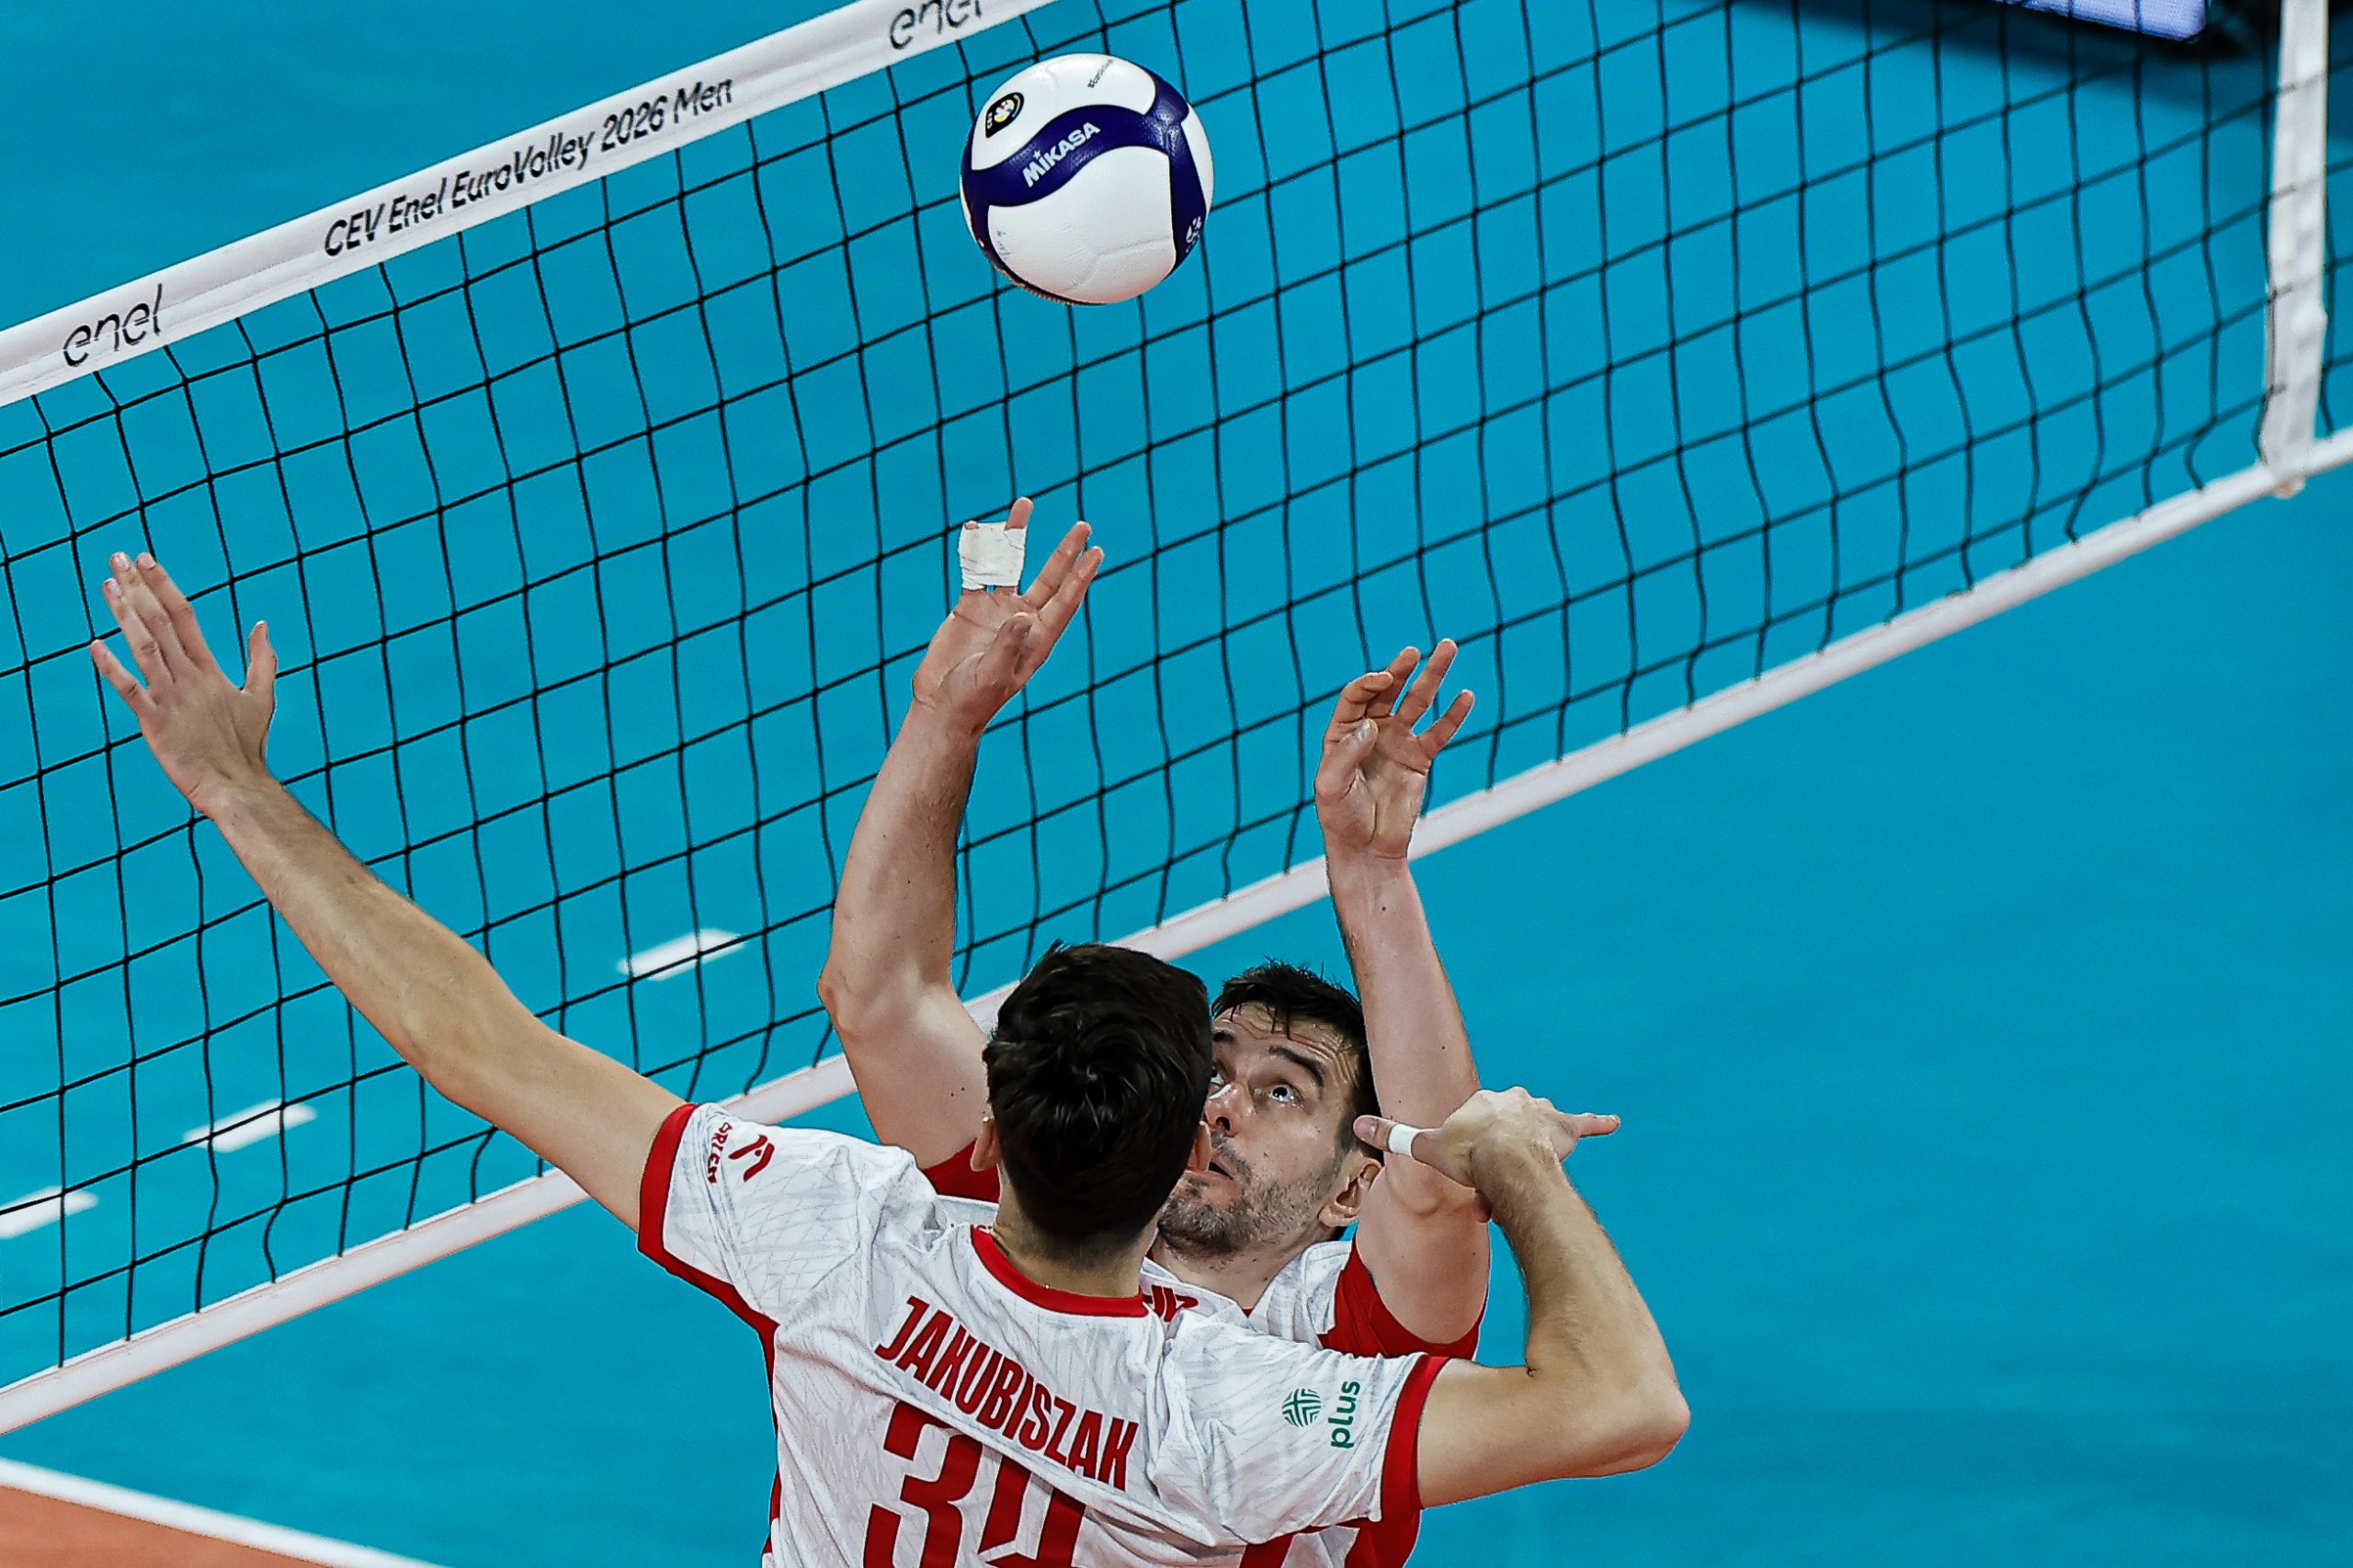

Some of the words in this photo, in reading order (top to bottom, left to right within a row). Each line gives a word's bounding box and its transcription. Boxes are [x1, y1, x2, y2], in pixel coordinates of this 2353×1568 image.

[324, 201, 384, 256] CEV
[389, 177, 448, 234] Enel
[451, 130, 596, 209] EuroVolley
[600, 95, 668, 153] 2026
[674, 77, 733, 124] Men
[63, 282, 163, 368] enel
[874, 1294, 1140, 1492] JAKUBISZAK
[1327, 1380, 1361, 1449] plus
